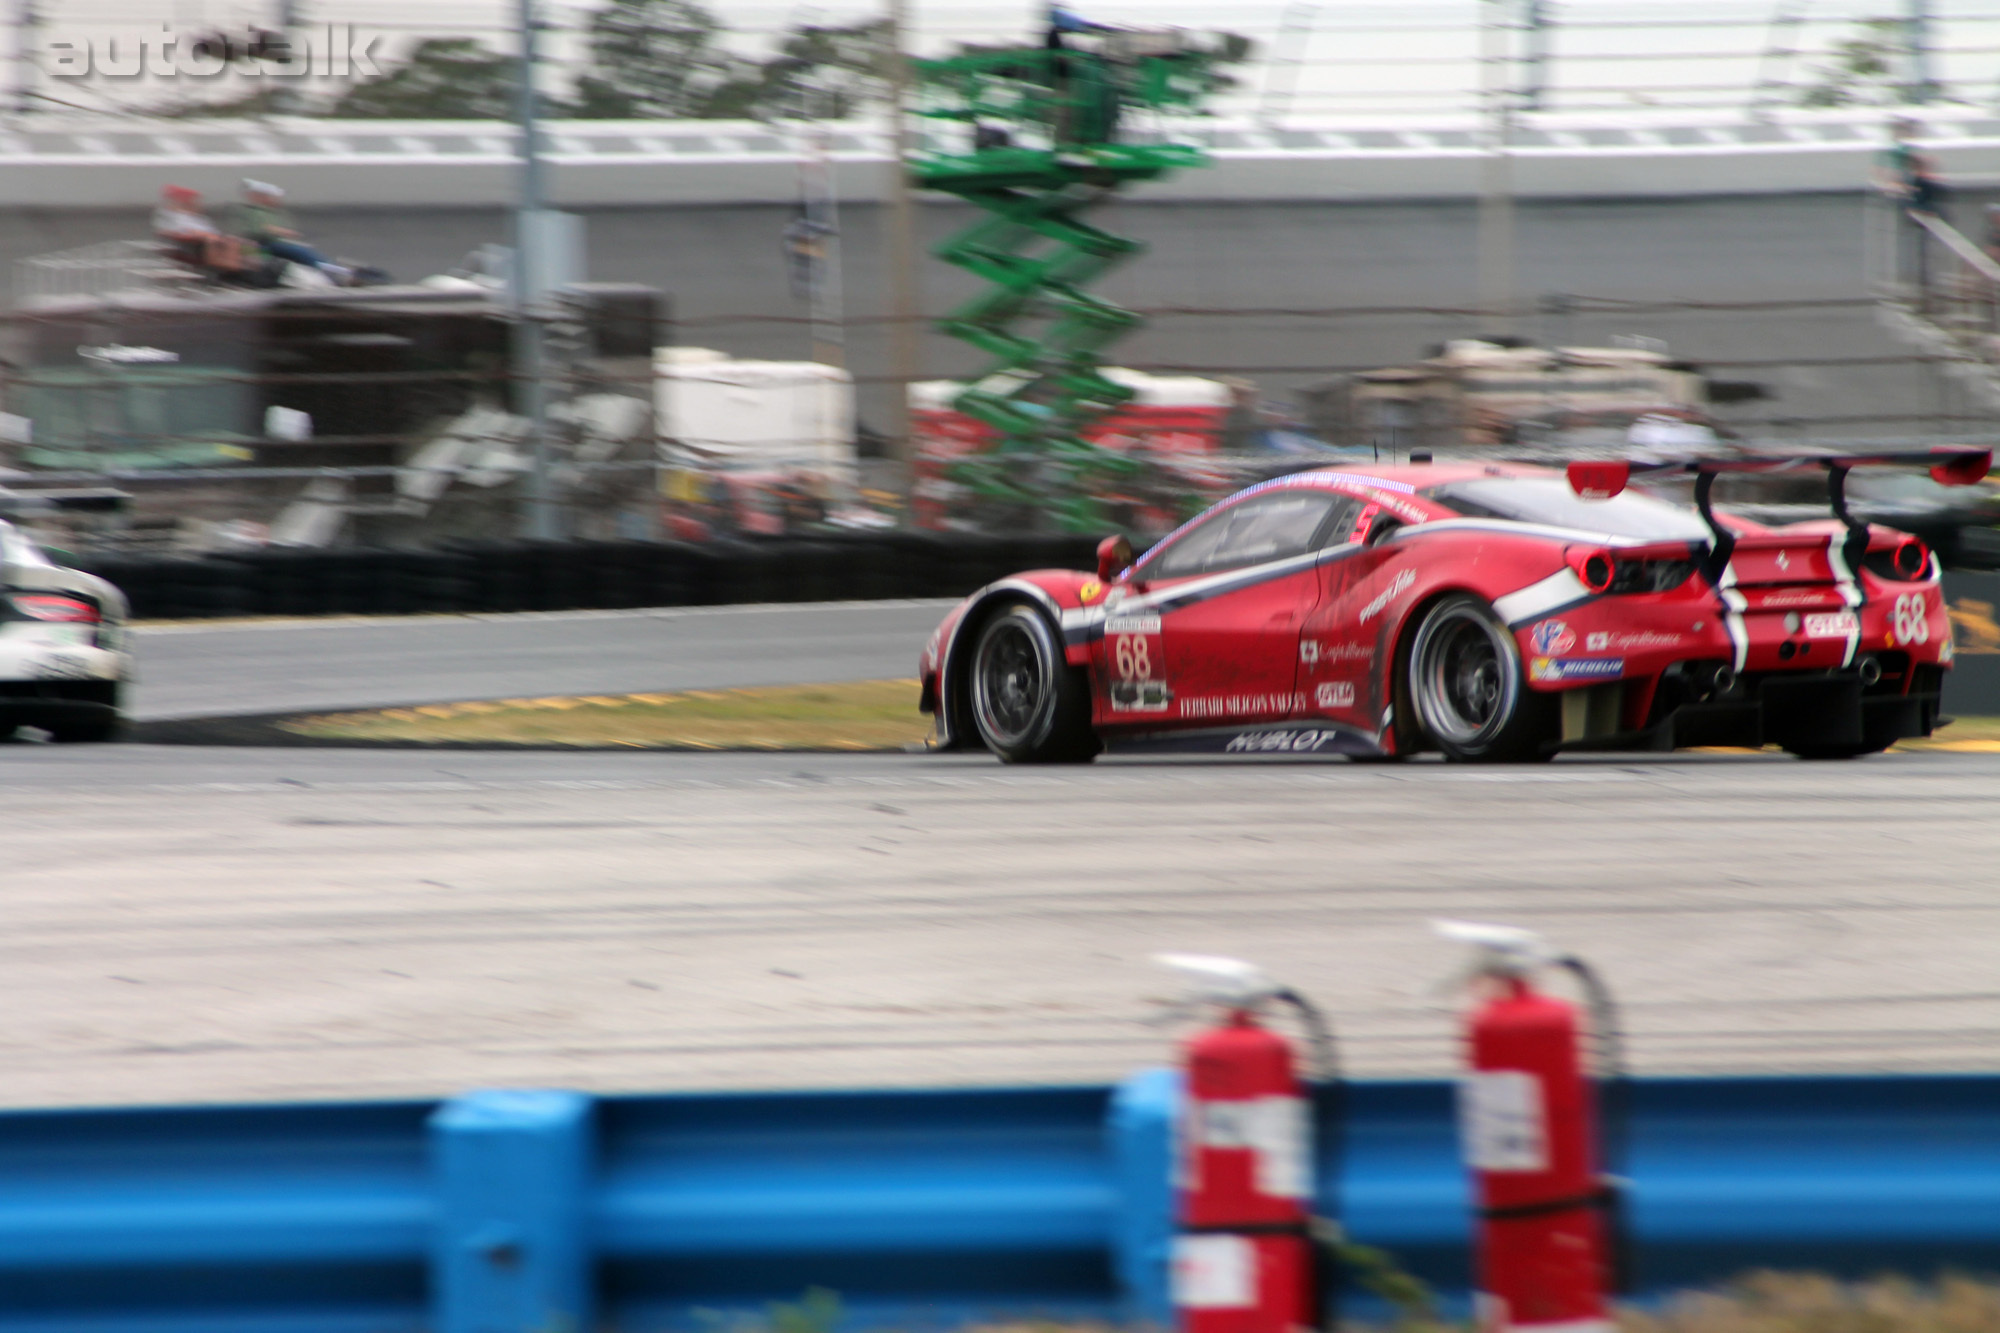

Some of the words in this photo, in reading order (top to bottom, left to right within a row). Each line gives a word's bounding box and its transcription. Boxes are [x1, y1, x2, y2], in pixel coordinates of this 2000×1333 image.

[1893, 591, 1929, 646] 68
[1116, 632, 1151, 682] 68
[1563, 660, 1624, 674] MICHELIN
[1180, 696, 1223, 718] FERRARI
[1226, 693, 1268, 715] SILICON
